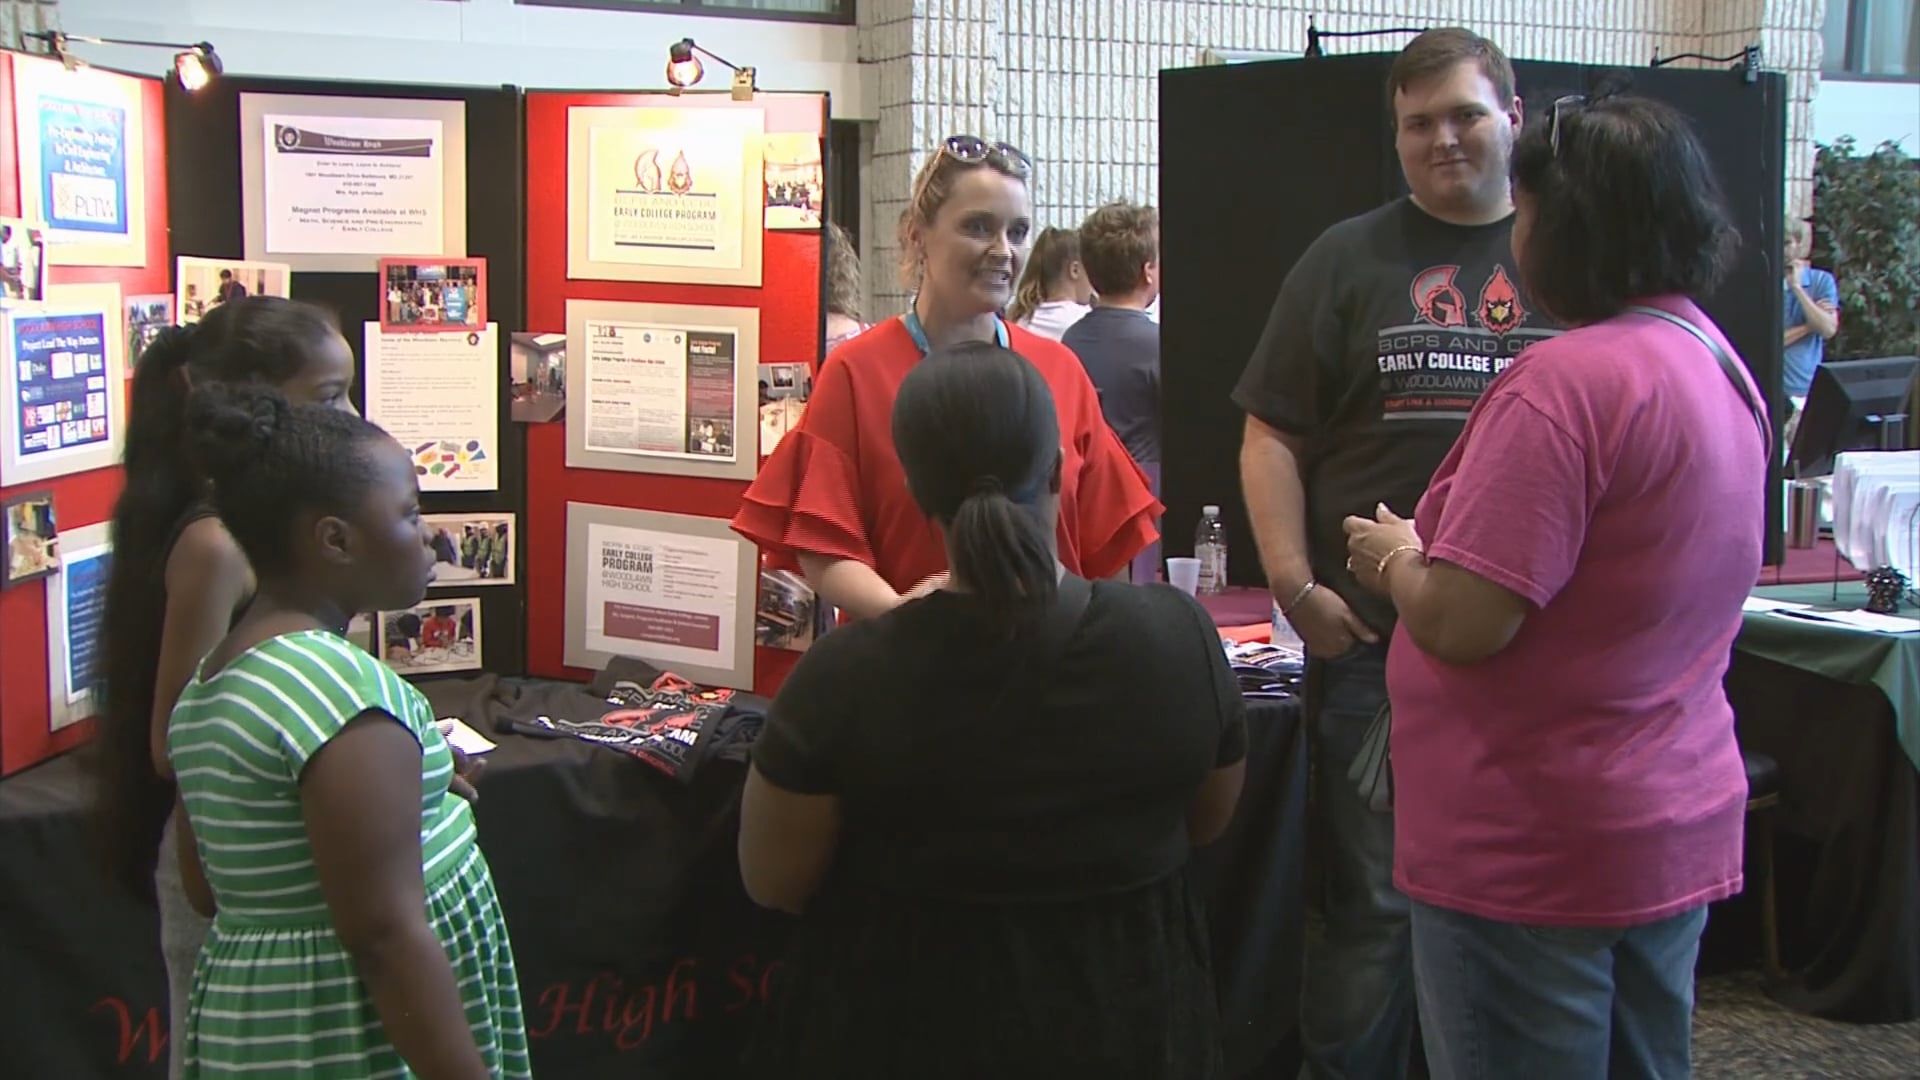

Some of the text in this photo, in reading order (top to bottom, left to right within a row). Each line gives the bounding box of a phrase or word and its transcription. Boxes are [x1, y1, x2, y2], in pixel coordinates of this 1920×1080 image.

[75, 194, 114, 218] PLTW
[292, 206, 320, 215] Magnet
[323, 207, 360, 216] Programs
[614, 207, 716, 220] EARLY COLLEGE PROGRAM
[1378, 335, 1440, 352] BCPS
[1447, 337, 1498, 353] AND
[1377, 352, 1425, 373] EARLY
[1428, 352, 1491, 373] COLLEGE
[1395, 373, 1479, 390] WOODLAWN
[602, 547, 653, 561] EARLY COLLEGE
[602, 557, 653, 573] PROGRAM
[602, 579, 653, 593] HIGH SCHOOL
[527, 959, 698, 1050] High
